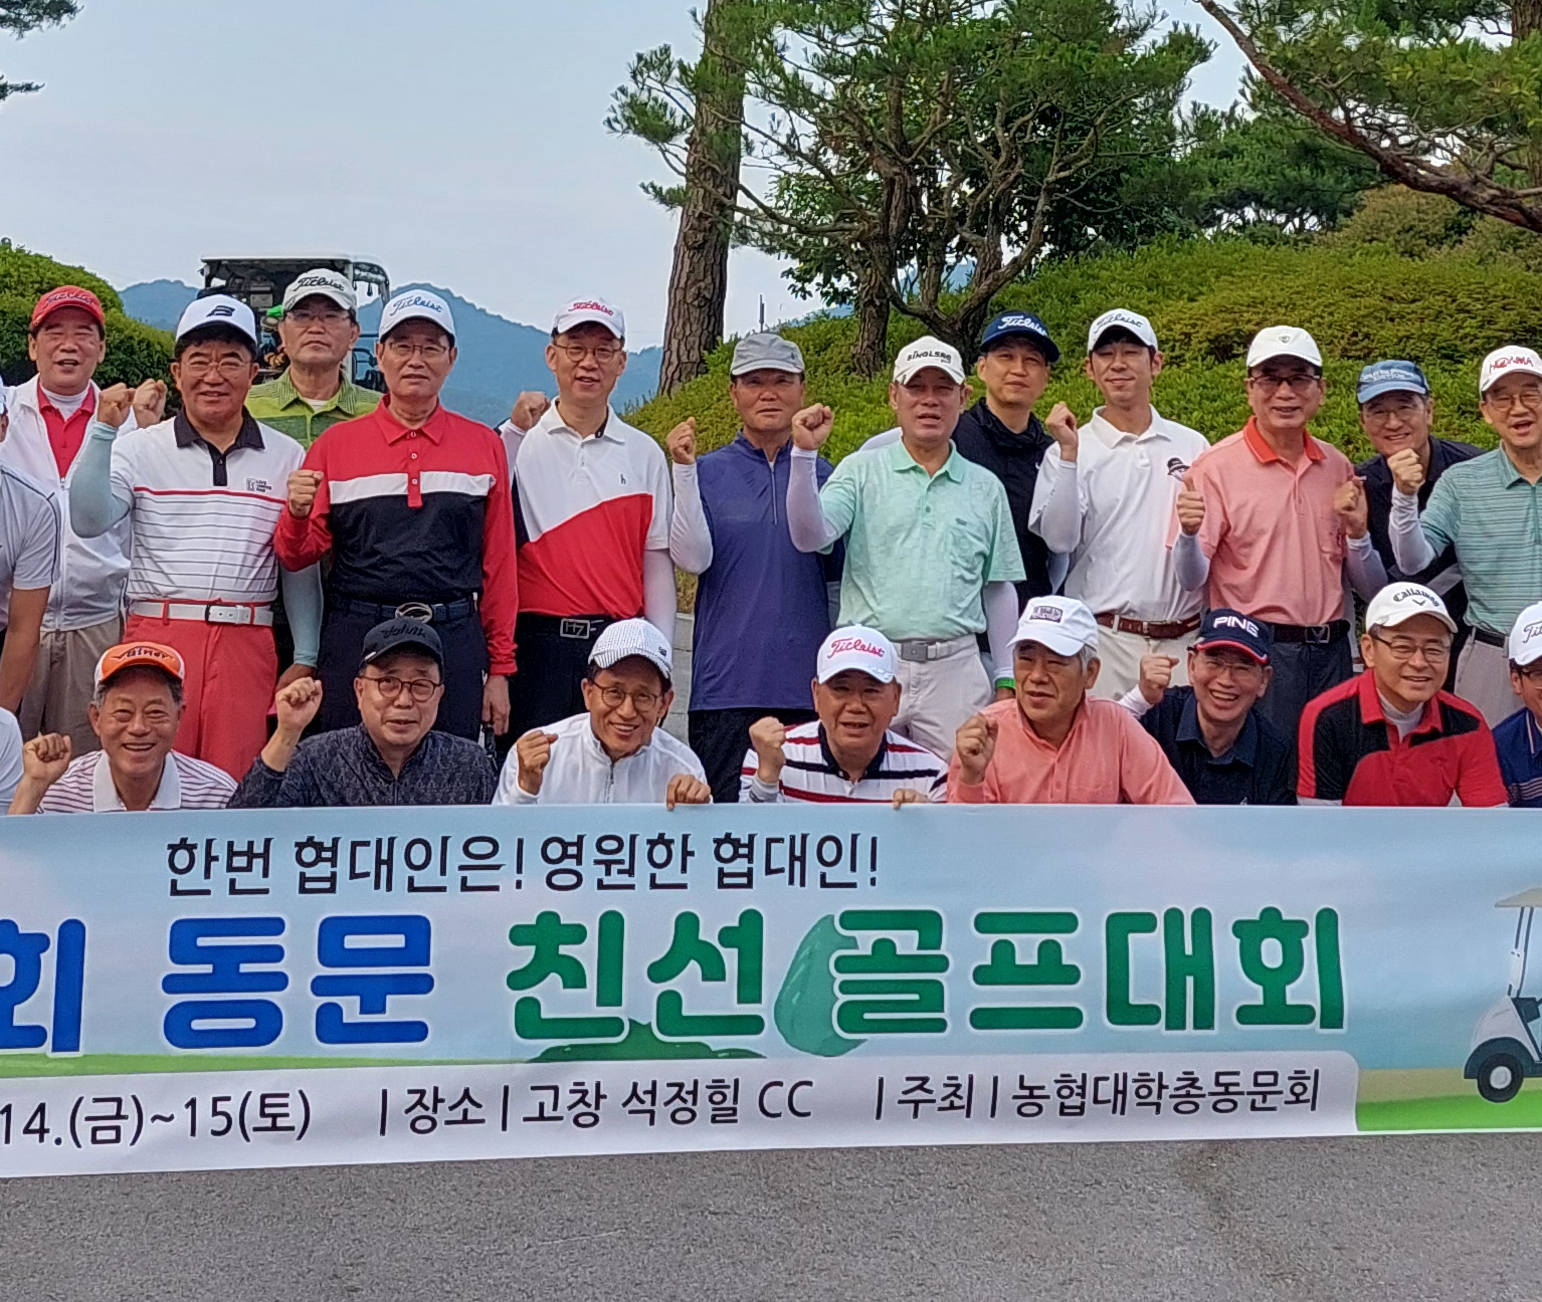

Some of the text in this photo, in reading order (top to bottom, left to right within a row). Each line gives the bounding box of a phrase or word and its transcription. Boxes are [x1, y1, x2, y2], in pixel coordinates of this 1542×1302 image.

[389, 296, 443, 317] Titleist
[1393, 587, 1441, 608] Callaway
[1213, 615, 1260, 638] PING
[826, 636, 887, 660] Titleist
[167, 831, 879, 897] 한번 협대인은! 영원한 협대인!
[161, 914, 435, 1050] 동문
[506, 908, 766, 1041] 친선
[832, 905, 1346, 1034] 골프대회
[522, 1080, 608, 1129] 고창
[621, 1077, 741, 1127] 석정힐
[757, 1079, 815, 1119] CC
[1011, 1068, 1321, 1119] 농협대학총동문회
